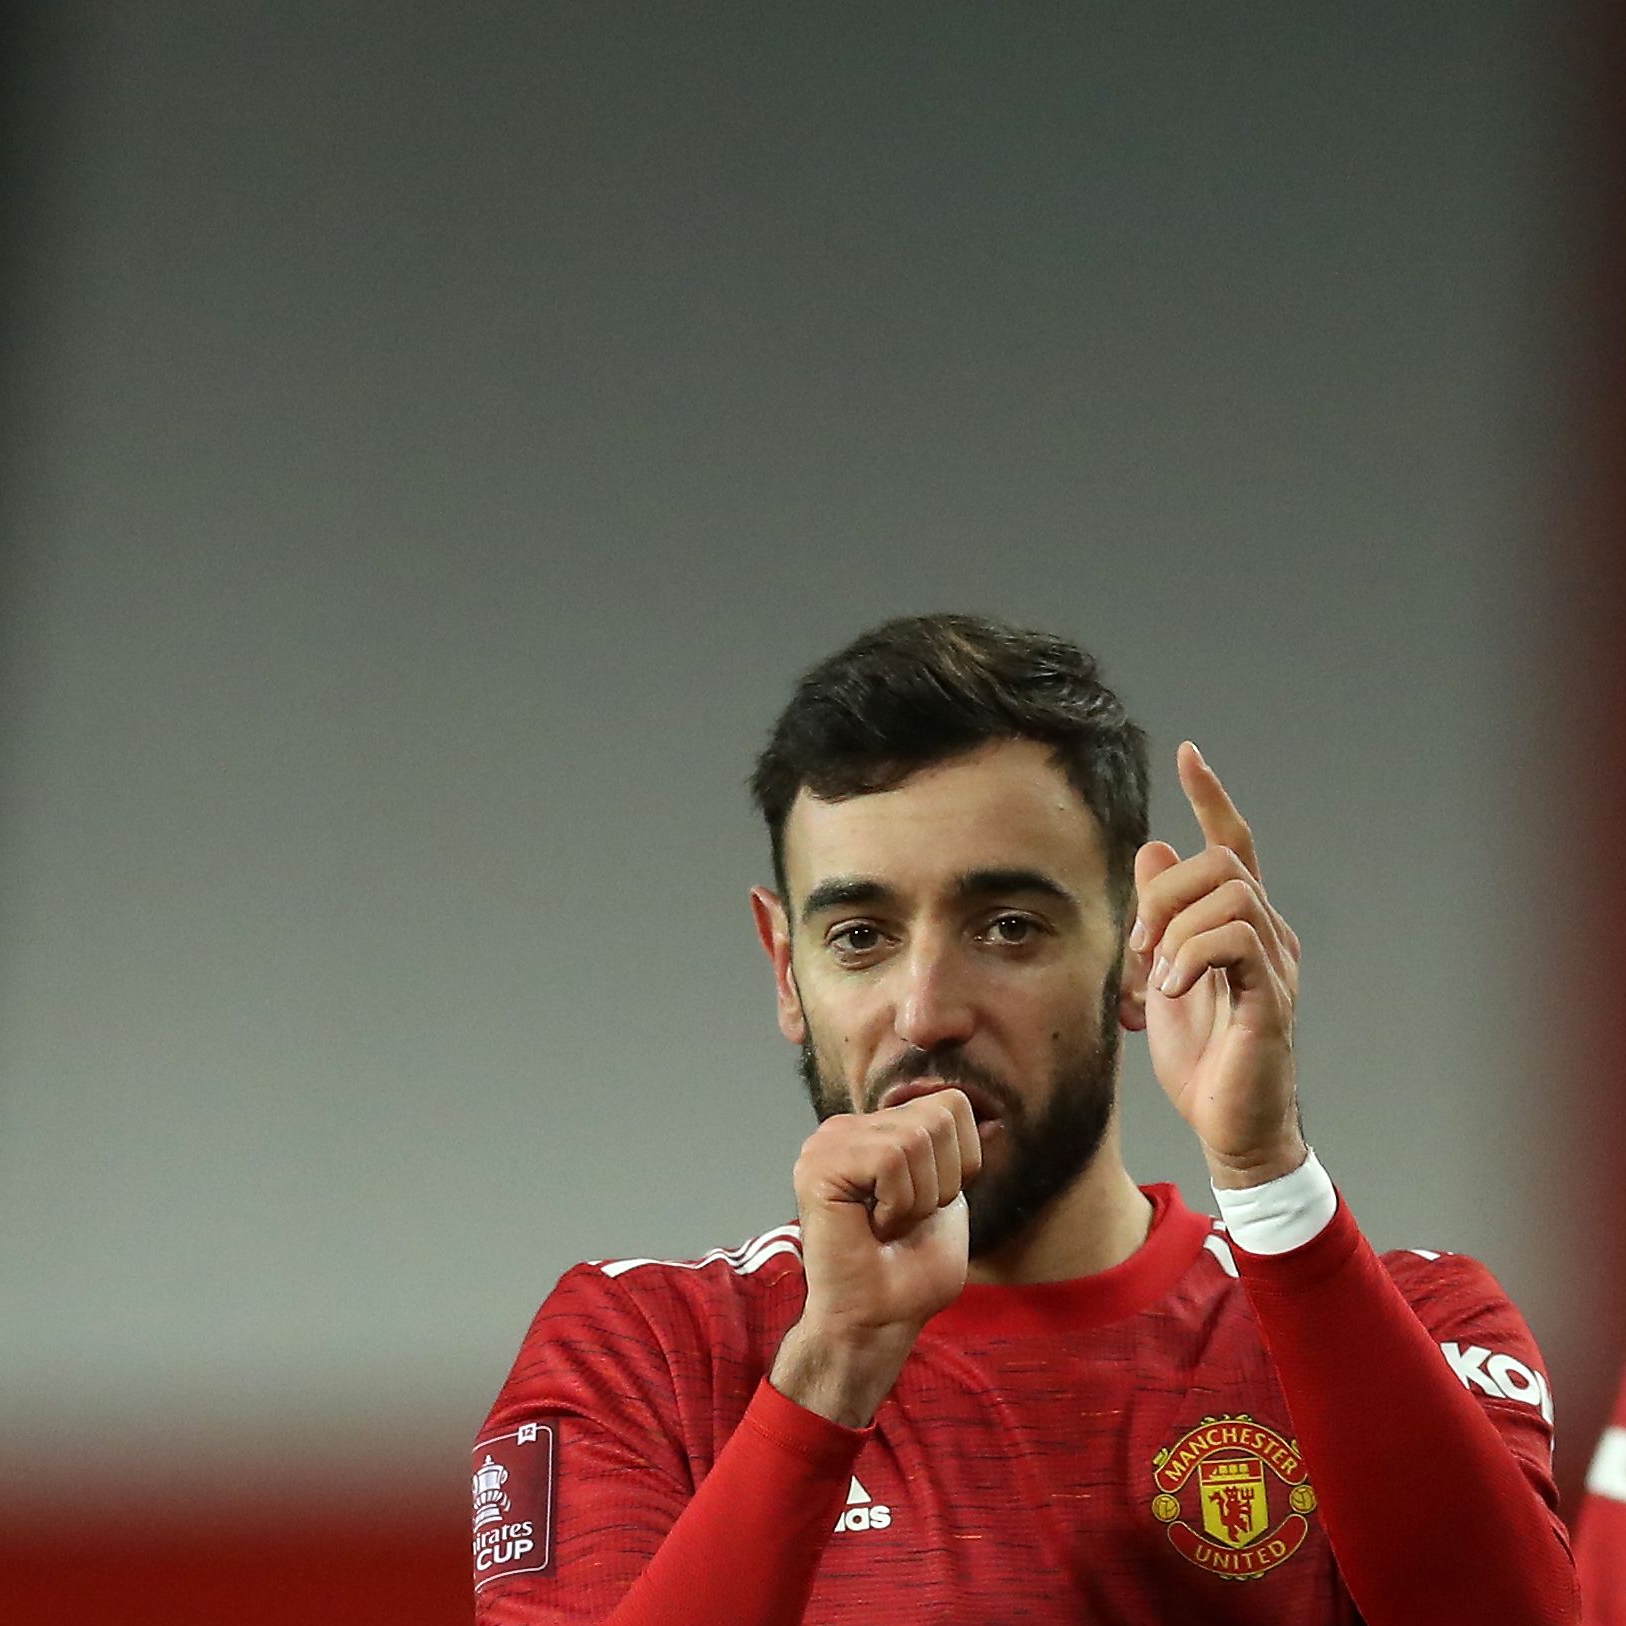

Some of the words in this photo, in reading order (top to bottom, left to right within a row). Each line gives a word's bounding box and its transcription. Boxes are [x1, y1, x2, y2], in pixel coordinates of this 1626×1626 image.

[1164, 1427, 1299, 1482] MANCHESTER
[473, 1521, 534, 1556] irates
[476, 1538, 535, 1571] CUP
[1195, 1539, 1287, 1570] UNITED
